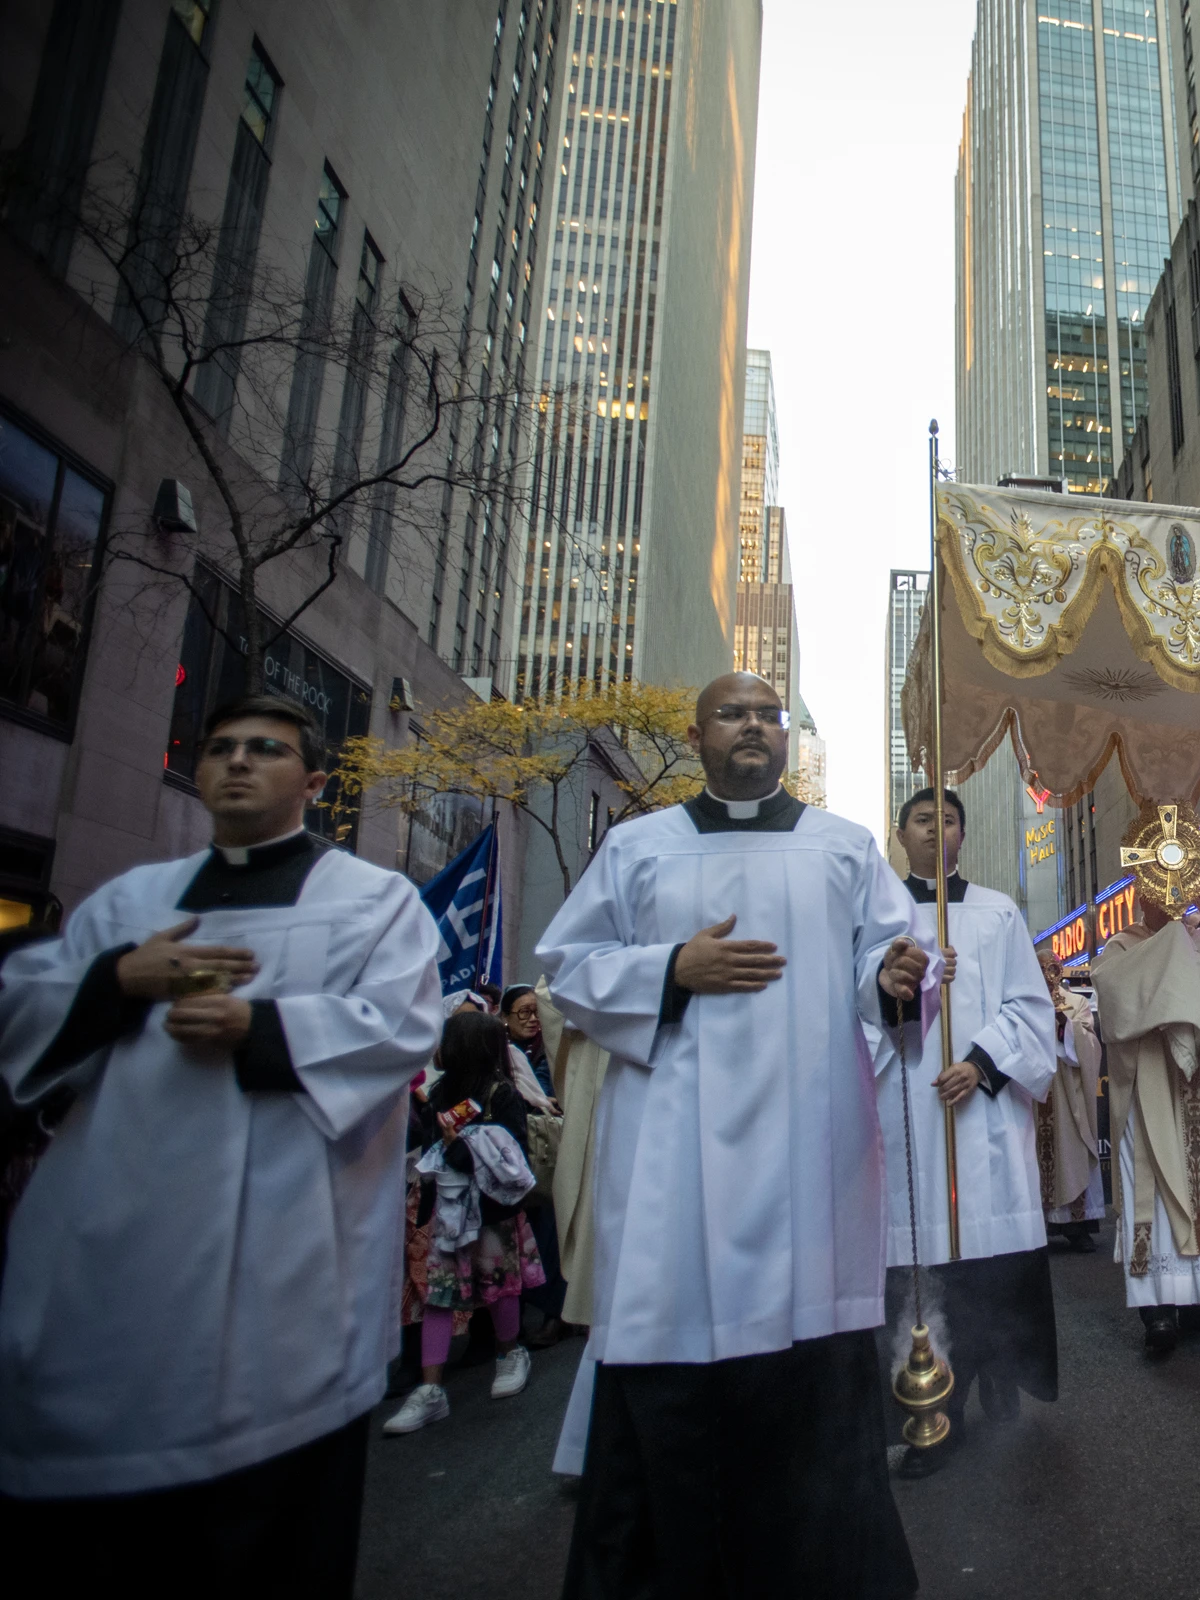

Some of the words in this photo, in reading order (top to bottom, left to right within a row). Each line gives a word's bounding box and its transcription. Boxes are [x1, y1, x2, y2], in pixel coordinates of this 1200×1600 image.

[264, 656, 281, 680] OF
[284, 667, 301, 695] THE
[1026, 820, 1055, 848] MUSIC
[1030, 843, 1056, 867] HALL
[1052, 917, 1085, 961] RADIO
[1099, 885, 1135, 939] CITY
